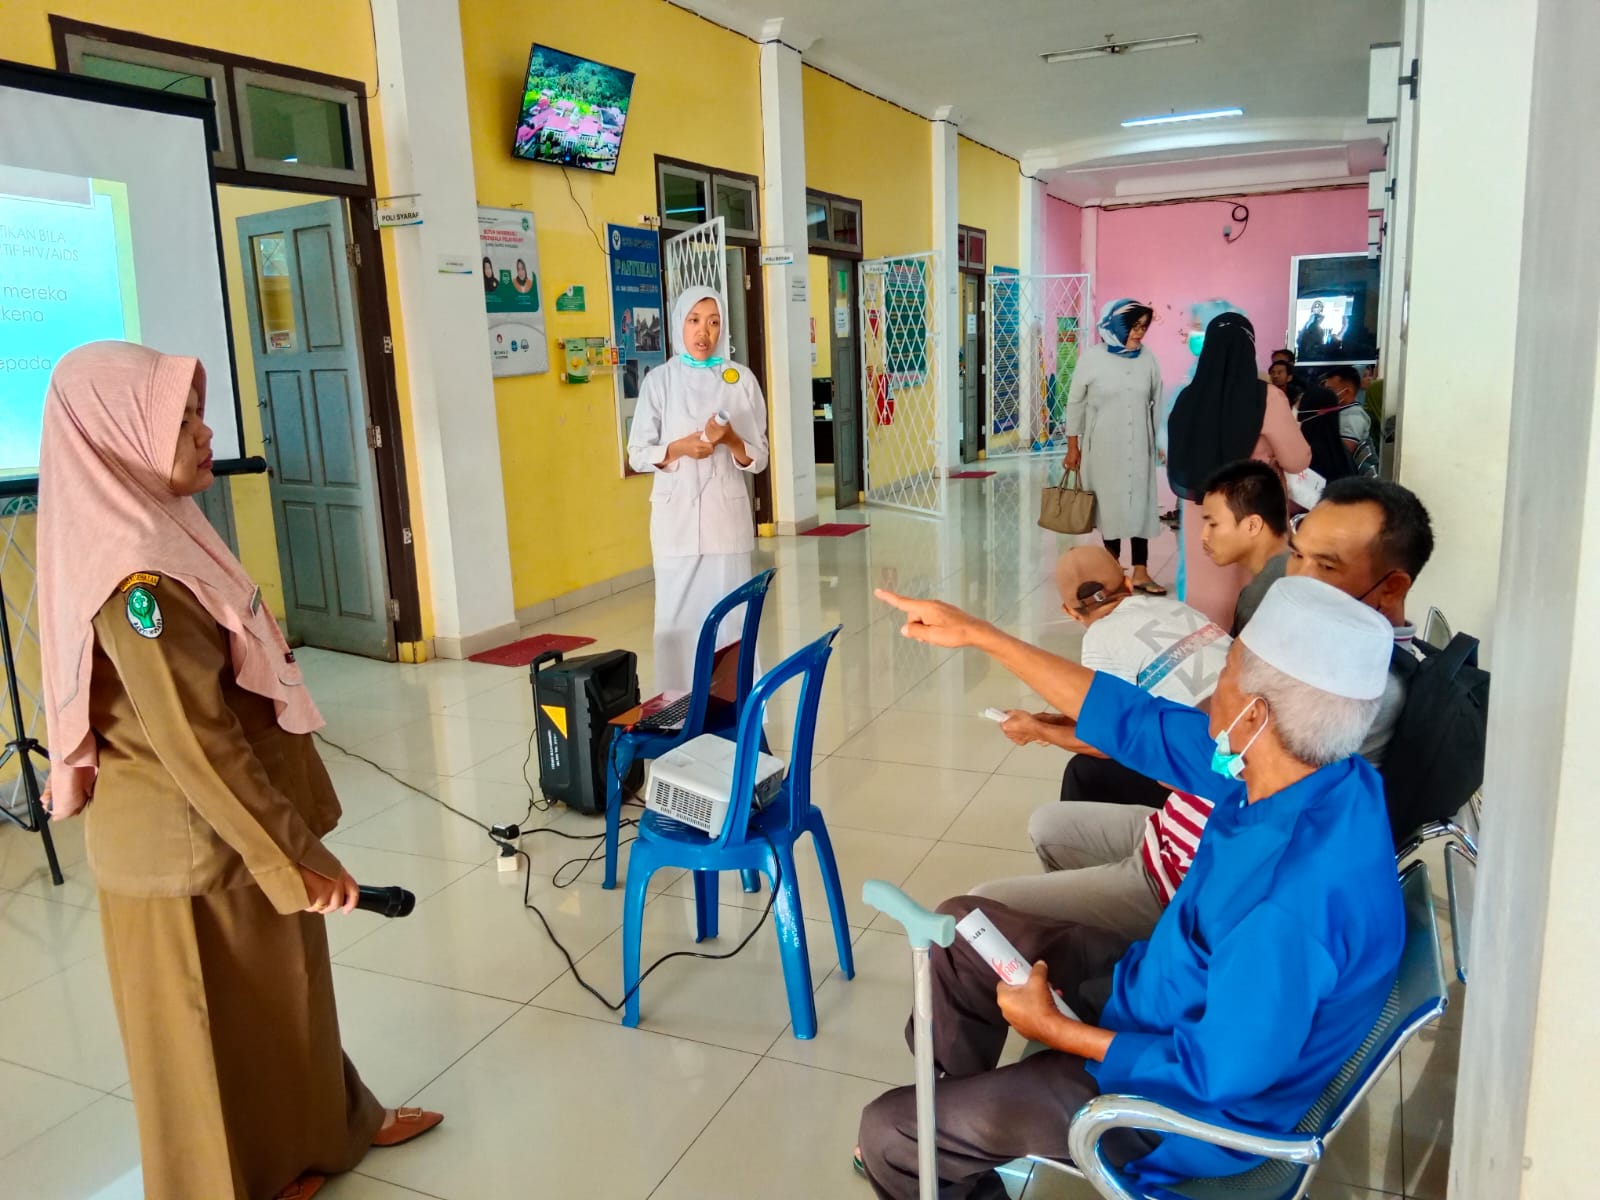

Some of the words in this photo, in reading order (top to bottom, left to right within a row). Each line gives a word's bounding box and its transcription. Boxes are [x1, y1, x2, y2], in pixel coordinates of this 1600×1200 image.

[381, 214, 396, 222] POLI
[39, 228, 66, 244] BILA
[22, 245, 79, 262] HIV/AIDS
[3, 285, 67, 302] mereka
[2, 304, 45, 322] kena
